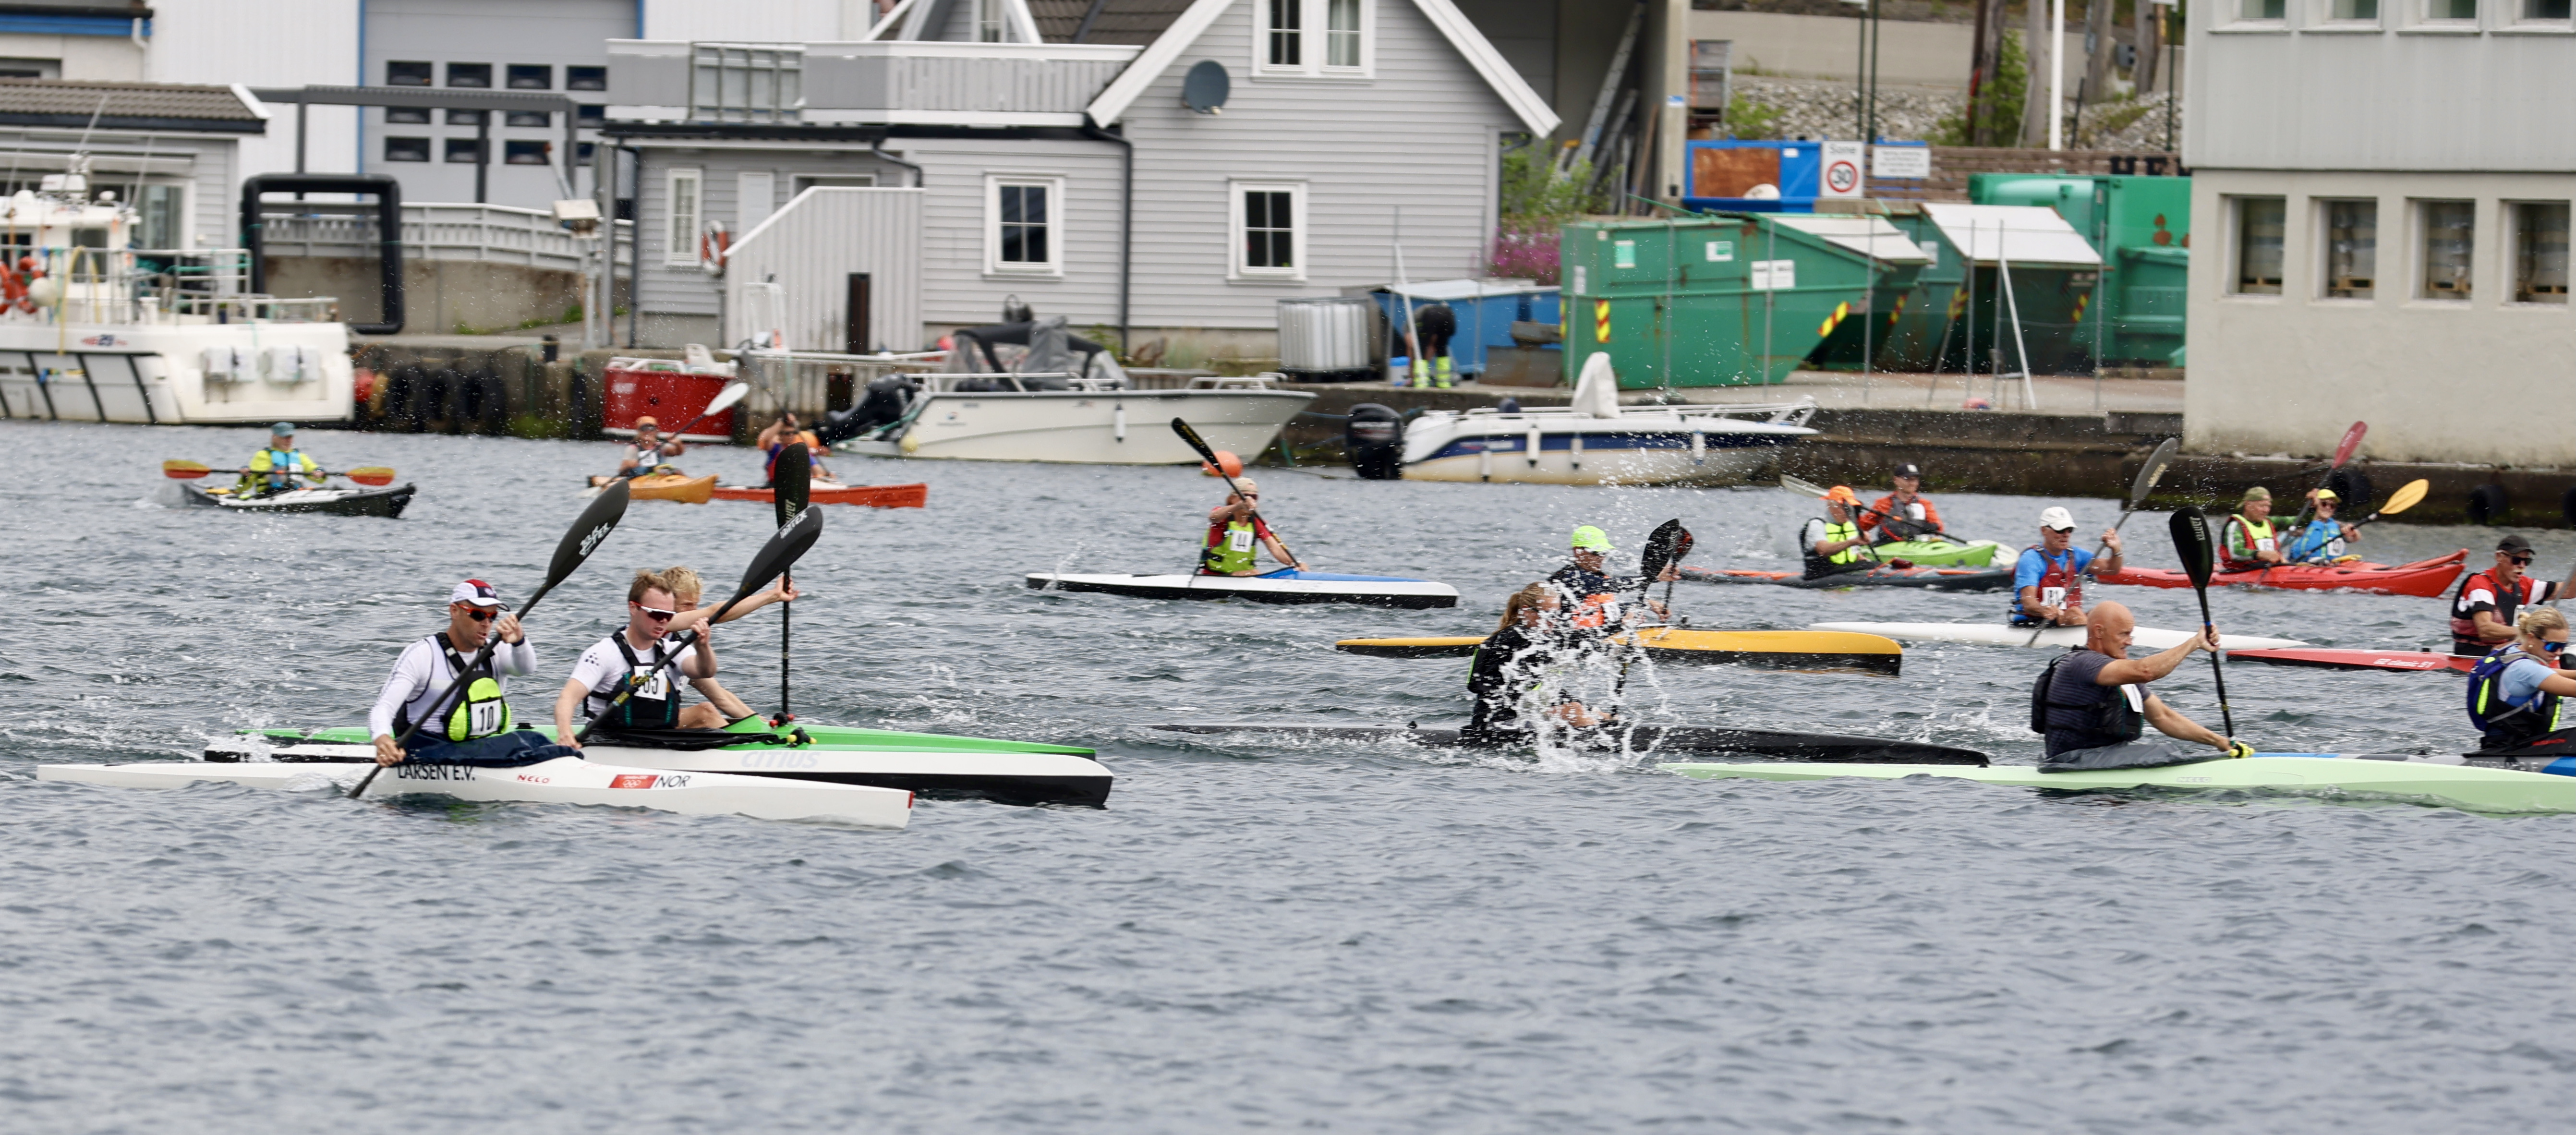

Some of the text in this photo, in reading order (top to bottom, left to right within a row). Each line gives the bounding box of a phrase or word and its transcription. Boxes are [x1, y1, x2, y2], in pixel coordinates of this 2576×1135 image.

[1833, 169, 1852, 184] 30
[480, 706, 494, 731] 10
[741, 751, 821, 768] CITIUS
[398, 765, 475, 781] LARSEN E.V.
[517, 774, 550, 784] NELO
[654, 775, 690, 787] NOR
